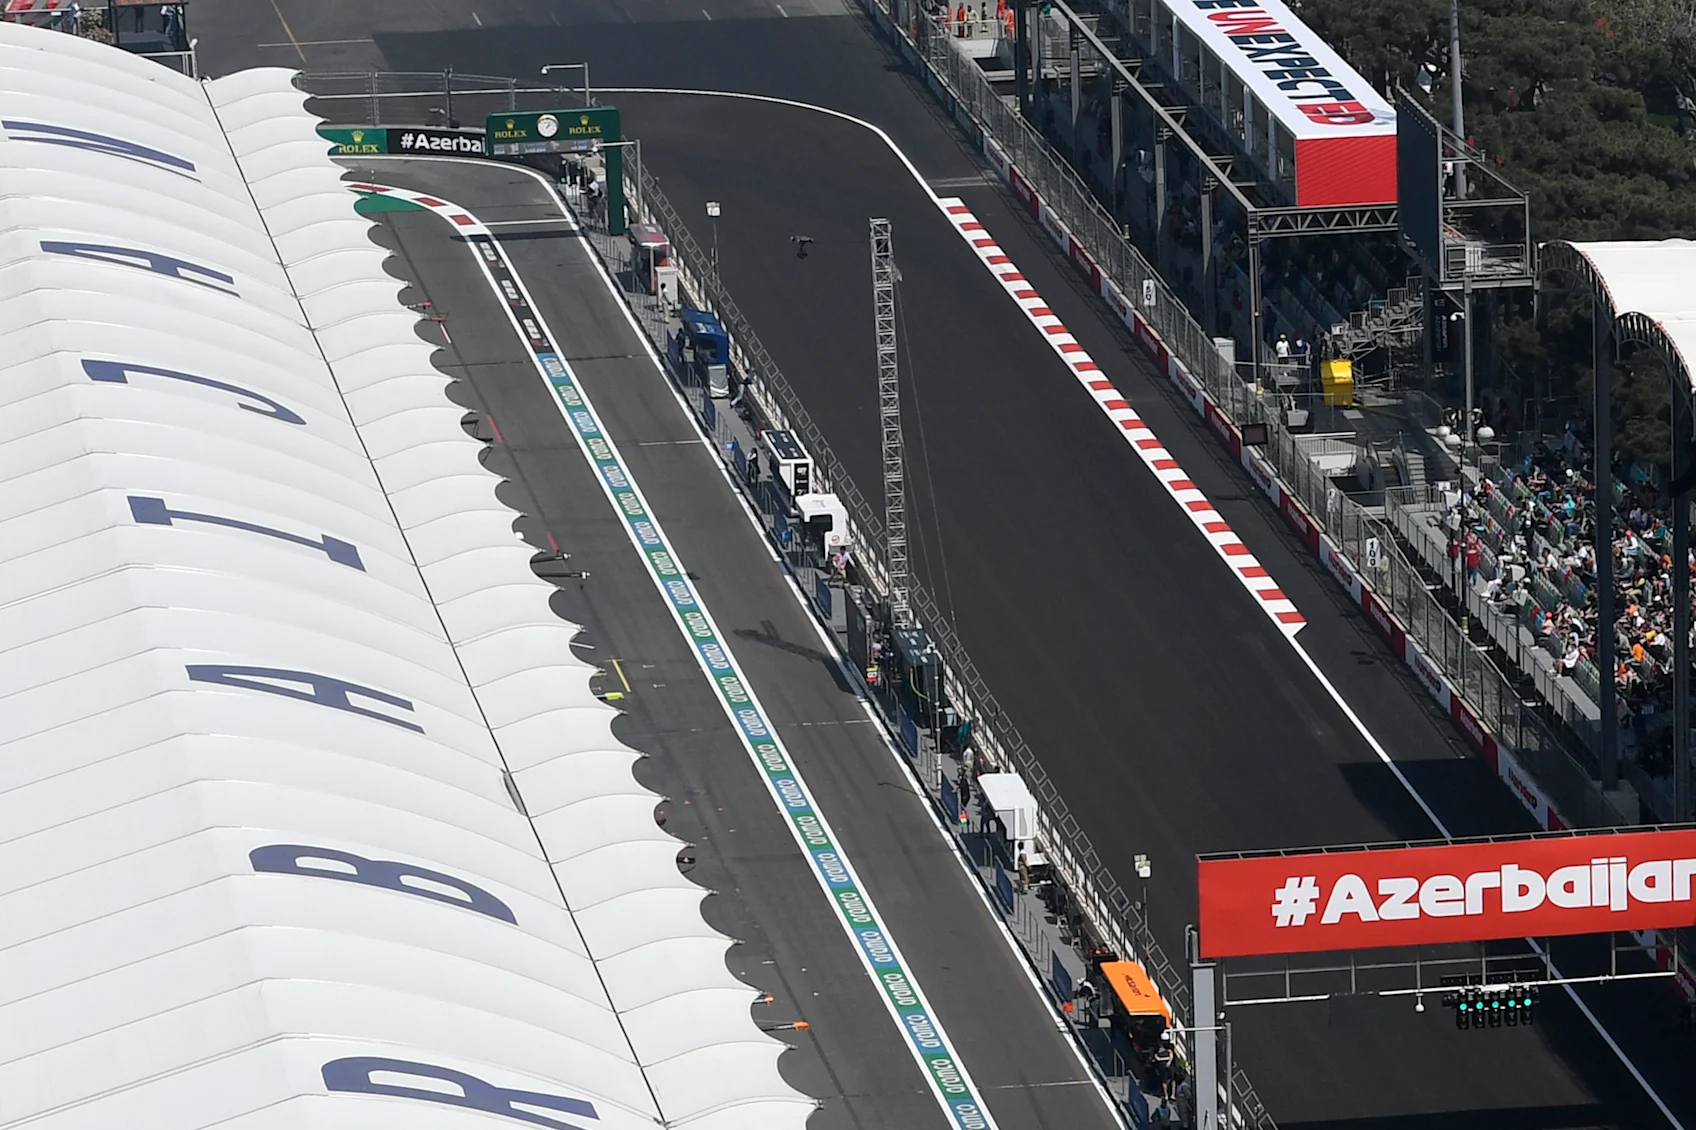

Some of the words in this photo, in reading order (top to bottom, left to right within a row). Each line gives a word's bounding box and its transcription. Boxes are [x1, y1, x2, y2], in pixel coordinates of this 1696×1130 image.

[1206, 10, 1376, 126] UNEXPECTED
[494, 130, 527, 139] ROLEX
[569, 126, 601, 135] ROLEX
[338, 144, 379, 154] ROLEX
[1369, 540, 1377, 567] 100
[776, 780, 806, 806] aramco
[797, 816, 827, 844] aramco
[818, 853, 848, 882] aramco
[839, 892, 871, 922] aramco
[861, 932, 893, 962] aramco
[883, 974, 917, 1005] aramco
[906, 1015, 940, 1047] aramco
[931, 1059, 965, 1092] aramco
